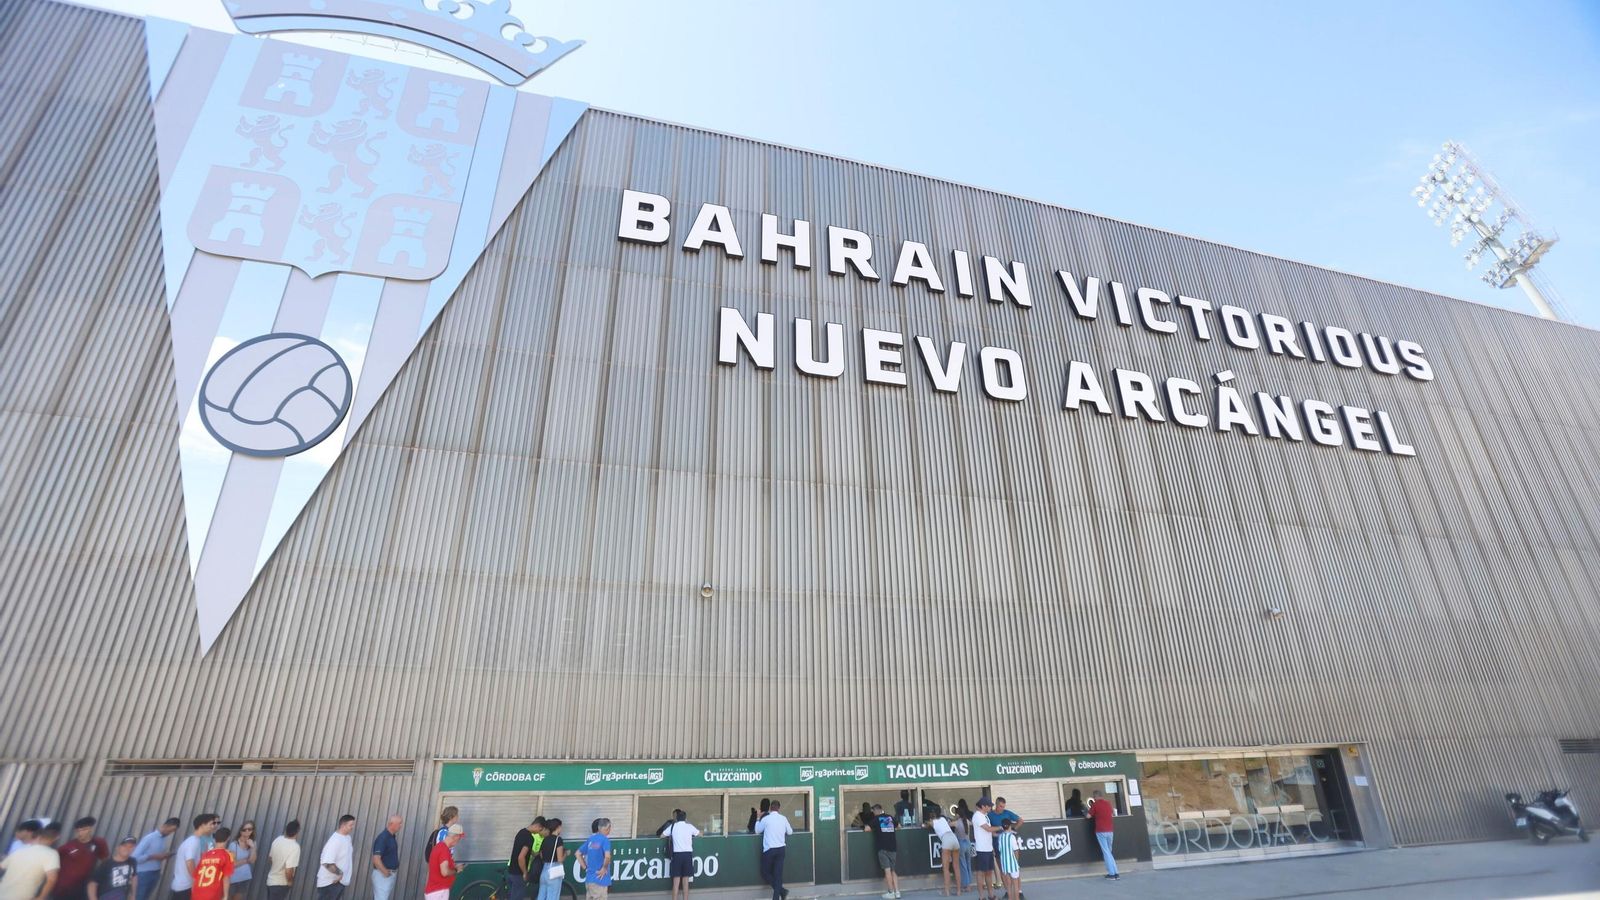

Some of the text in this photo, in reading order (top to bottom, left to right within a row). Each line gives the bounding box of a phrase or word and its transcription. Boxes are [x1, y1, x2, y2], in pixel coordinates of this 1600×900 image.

[618, 189, 1434, 381] BAHRAIN VICTORIOUS
[718, 306, 1416, 456] NUEVO ARCÁNGEL
[485, 771, 546, 782] CÓRDOBA CF
[704, 769, 762, 783] Cruzcampo
[815, 768, 855, 778] rg3print.es
[886, 762, 969, 779] TAQUILLAS
[996, 763, 1043, 775] Cruzcampo
[602, 772, 648, 782] rg3print.es
[1048, 834, 1067, 851] RG3
[198, 866, 217, 887] 19
